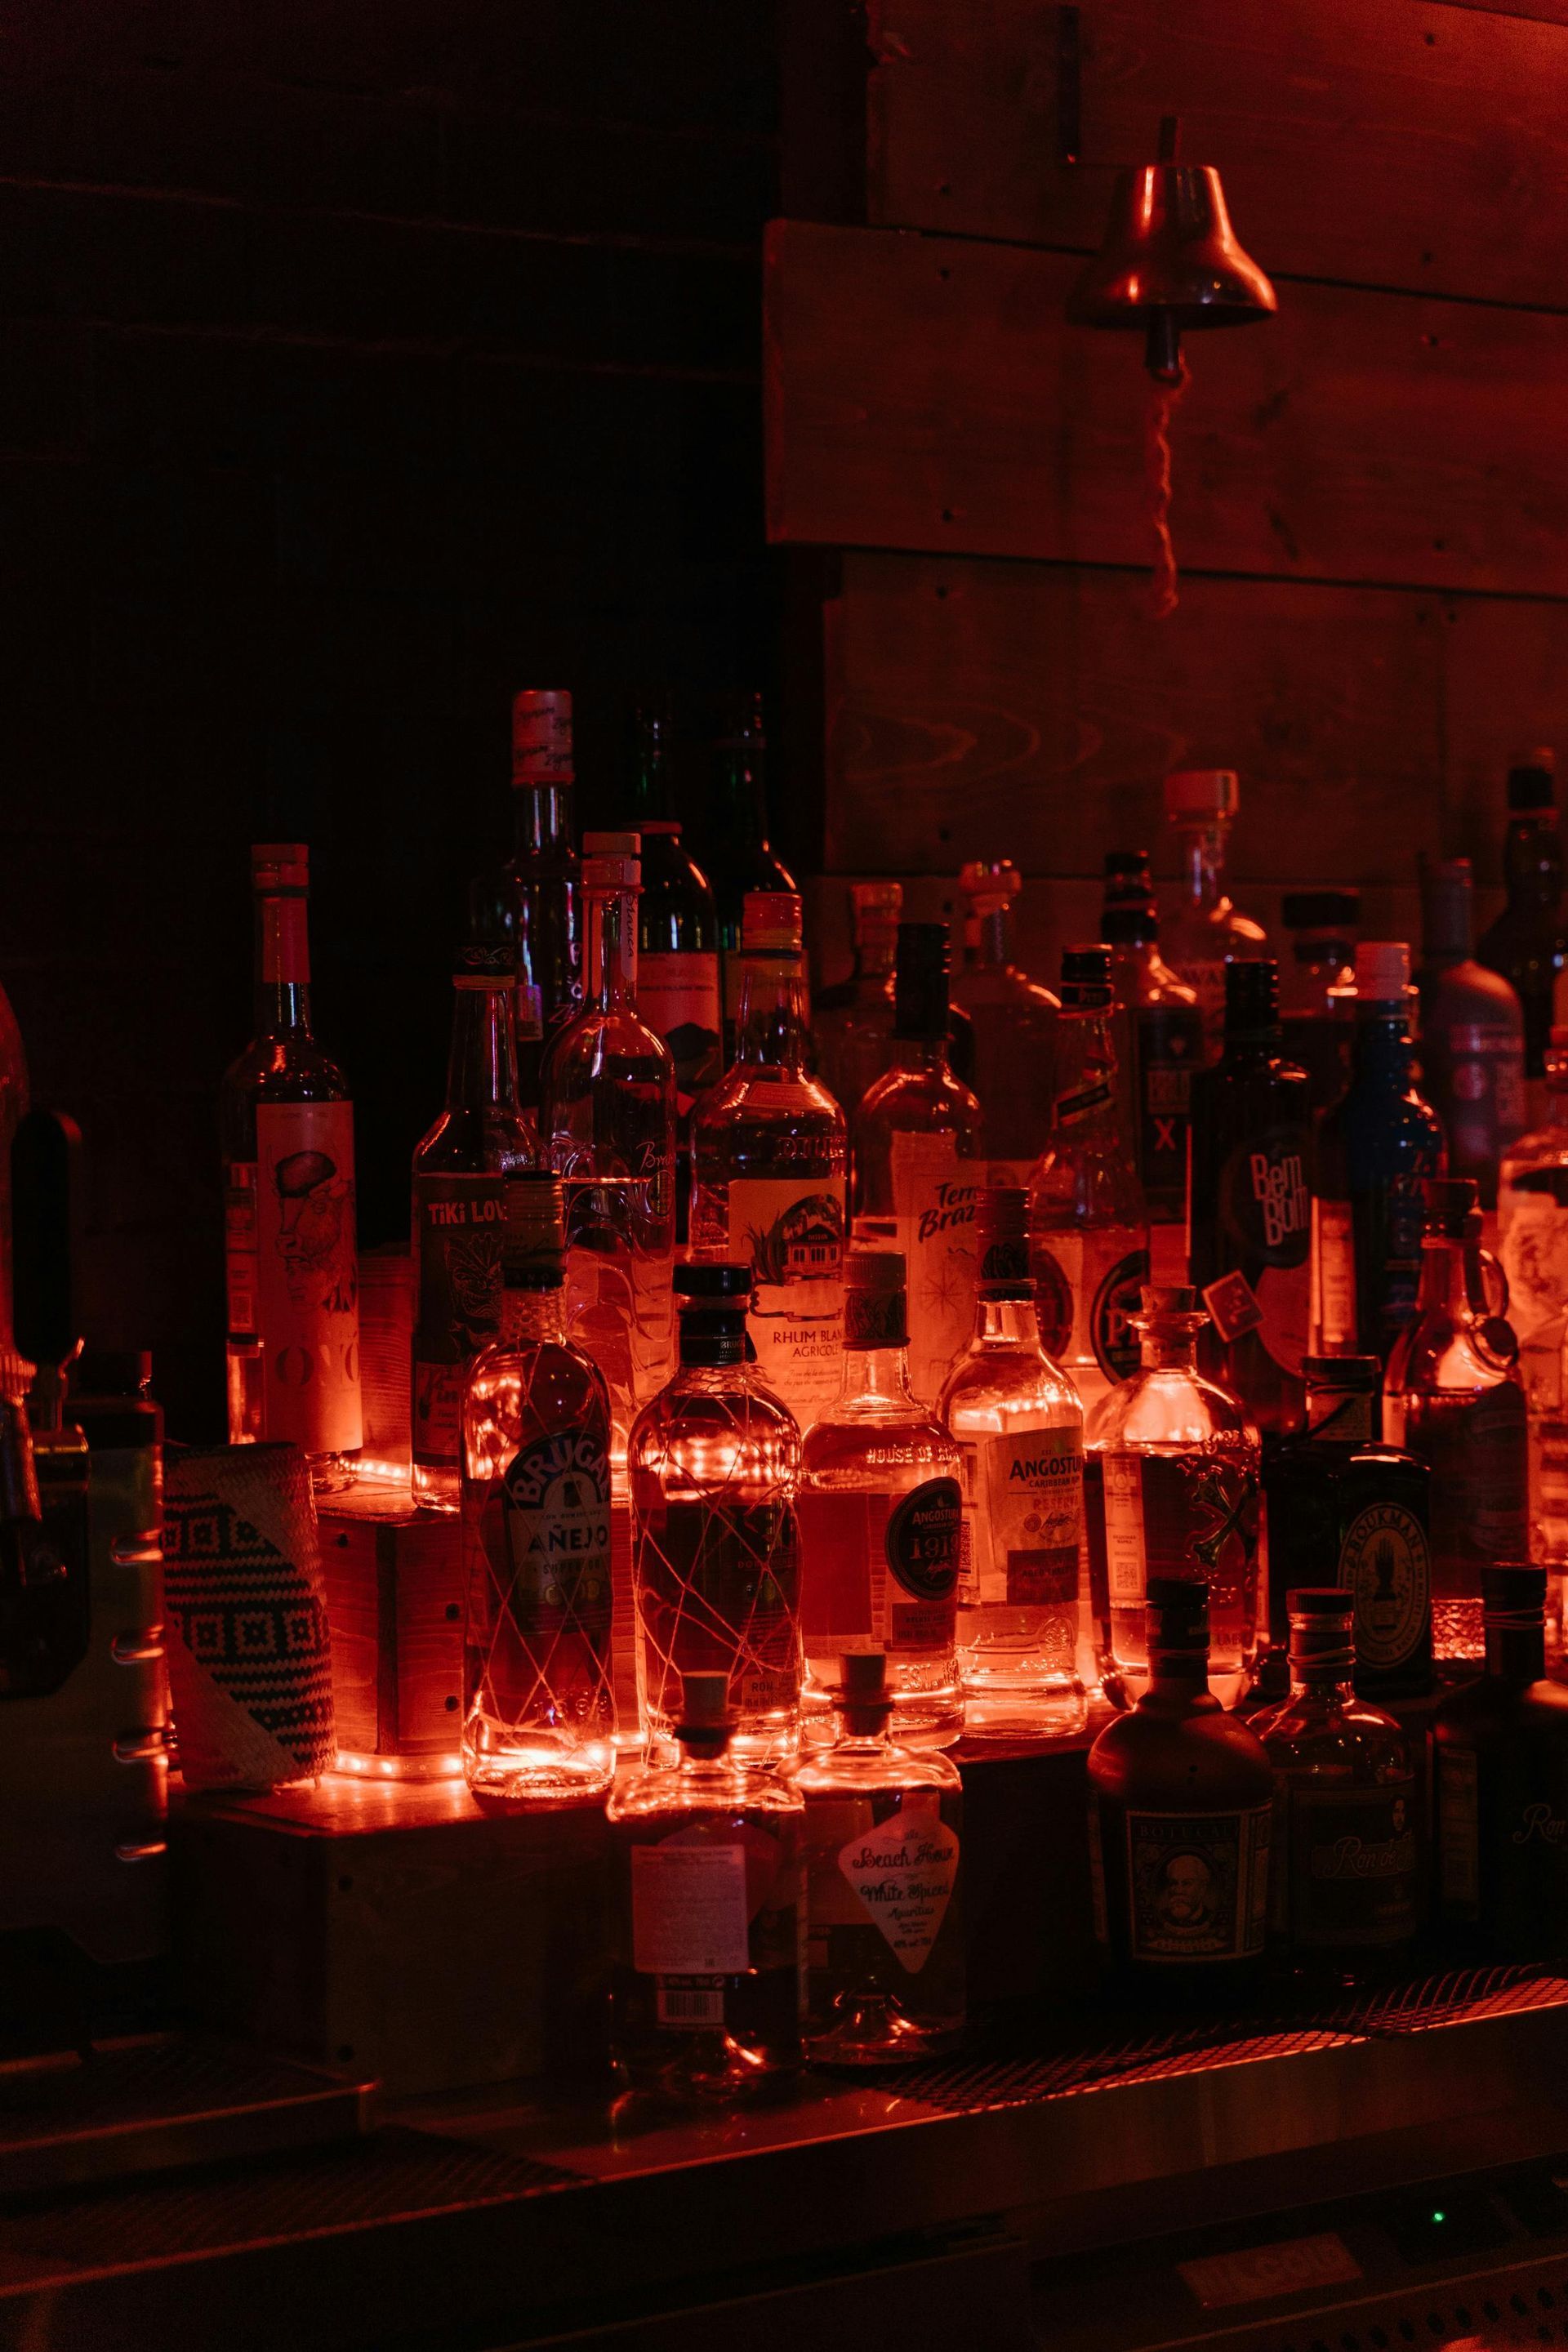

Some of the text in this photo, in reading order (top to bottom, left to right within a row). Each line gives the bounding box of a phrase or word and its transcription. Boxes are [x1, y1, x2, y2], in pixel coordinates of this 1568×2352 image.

[773, 1330, 816, 1344] RHUM
[528, 1523, 608, 1553] AÑEJO
[1349, 1509, 1420, 1551] BOUKMAN
[852, 1846, 911, 1869] Beach
[860, 1879, 904, 1903] White
